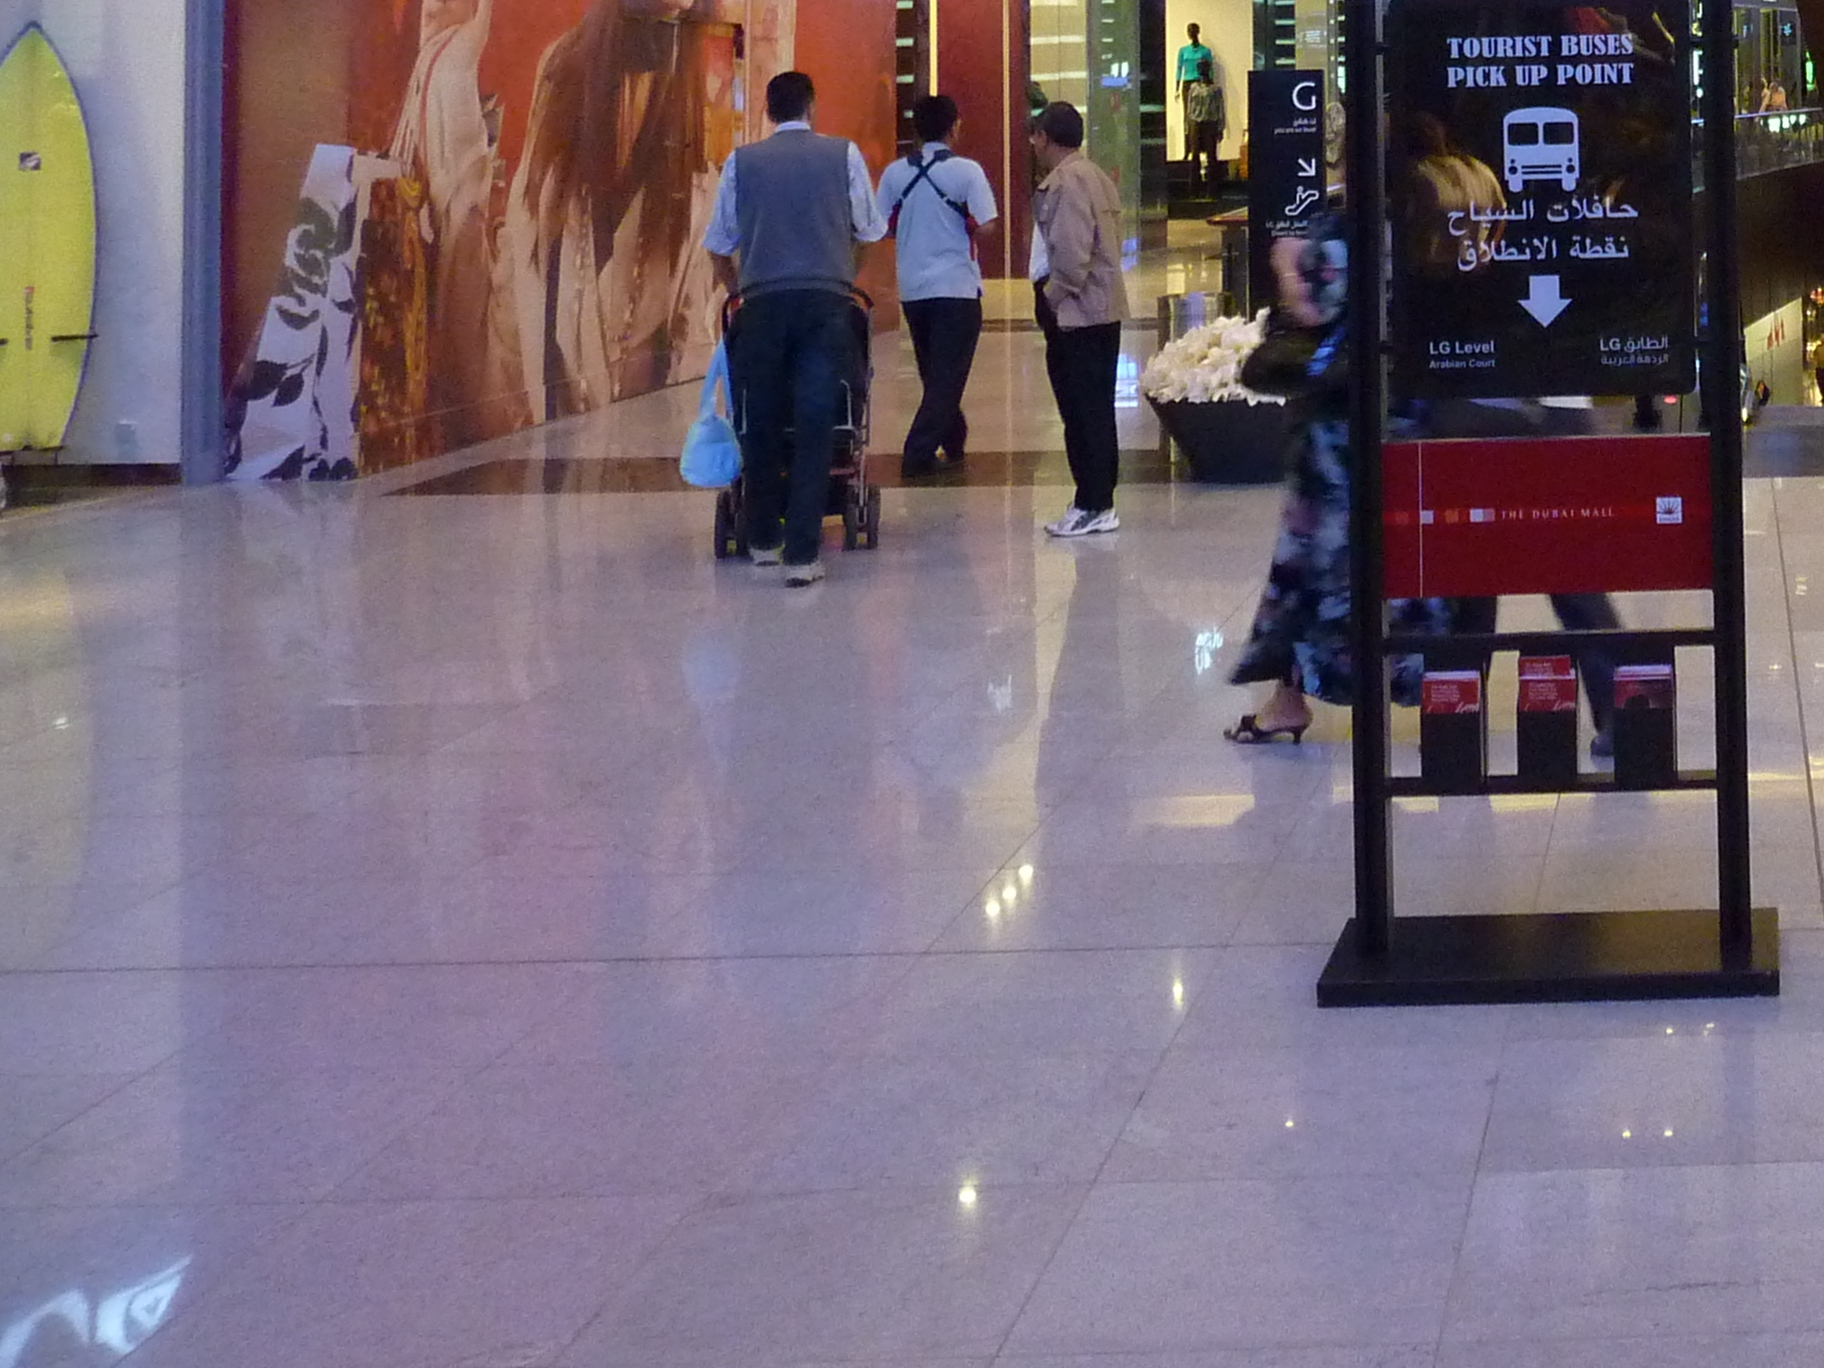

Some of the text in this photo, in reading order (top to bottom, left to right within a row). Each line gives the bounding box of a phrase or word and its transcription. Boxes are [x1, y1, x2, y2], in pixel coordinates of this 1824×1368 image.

[1446, 33, 1634, 59] TOURIST BUSES
[1447, 63, 1634, 88] PICK UP POINT
[1292, 82, 1317, 111] G
[1457, 235, 1630, 272] نقطة الانطلاق
[1429, 340, 1495, 355] LG Level
[1600, 338, 1621, 351] LG
[1532, 509, 1575, 519] DUBAI
[1580, 507, 1614, 518] MALL
